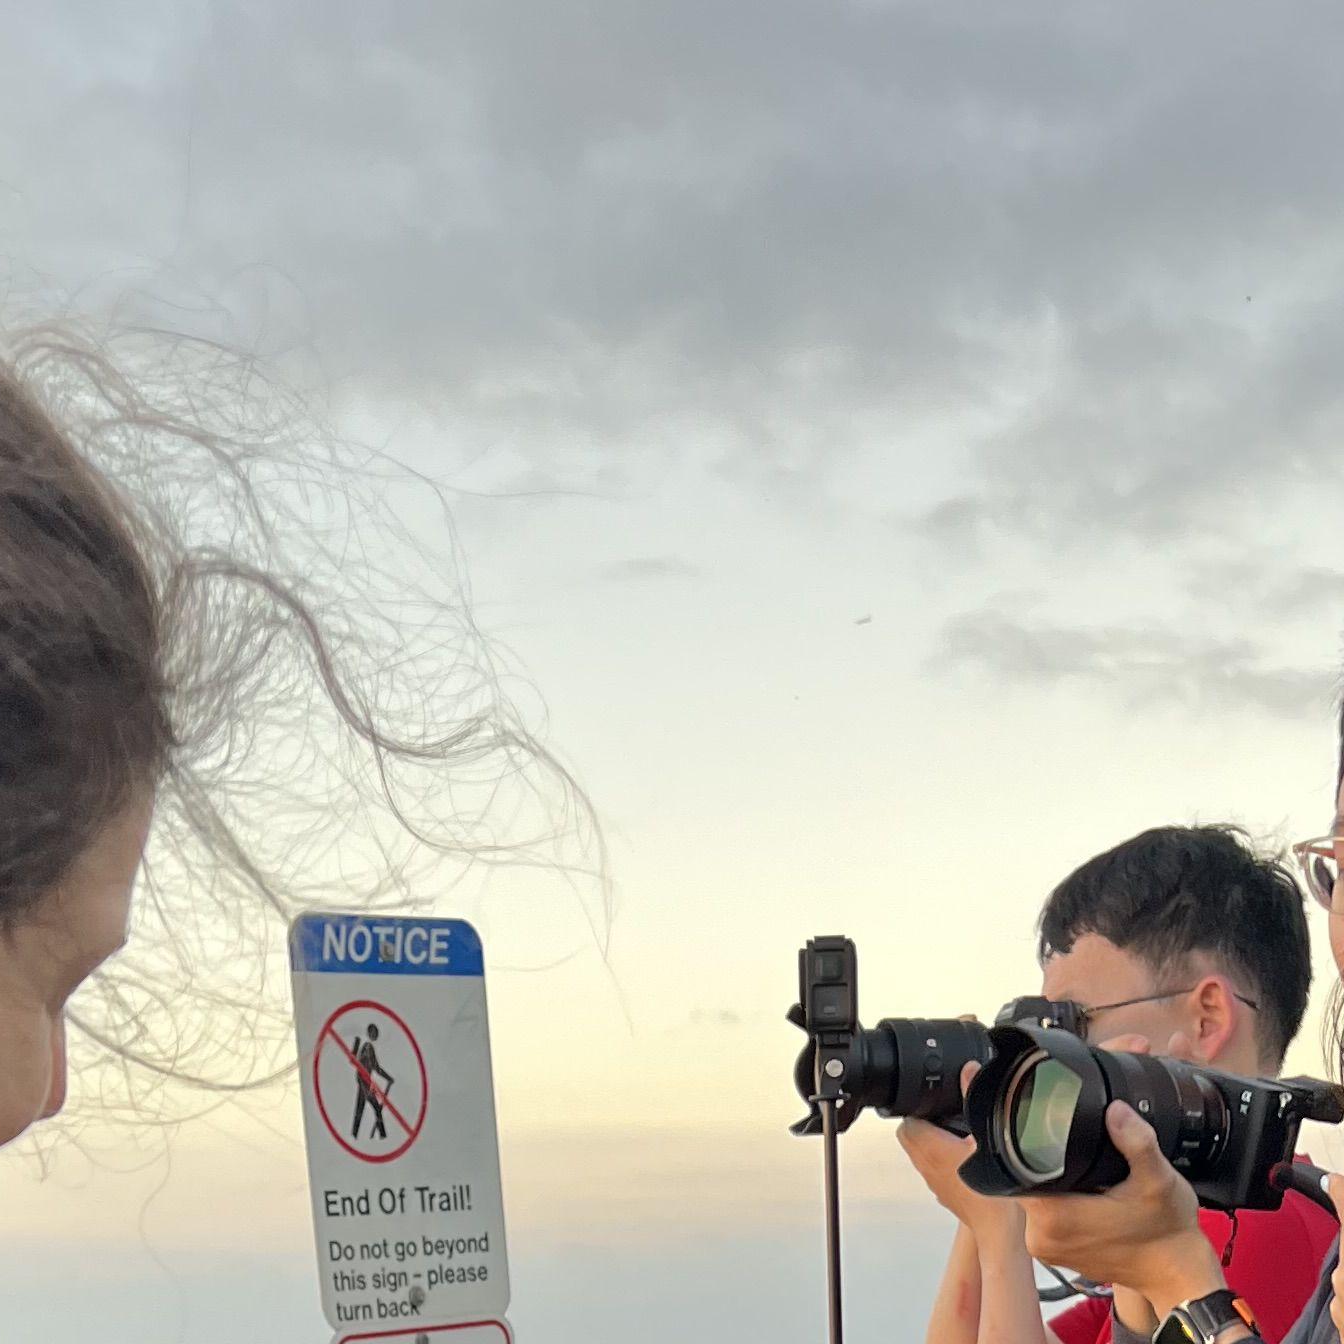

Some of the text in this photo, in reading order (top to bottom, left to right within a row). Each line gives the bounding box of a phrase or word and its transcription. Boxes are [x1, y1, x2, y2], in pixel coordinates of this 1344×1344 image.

[322, 924, 451, 964] NOTICE
[324, 1185, 471, 1217] End Of Trail!
[329, 1232, 489, 1262] Do not go beyond
[334, 1270, 367, 1292] this
[372, 1268, 409, 1292] sign
[427, 1264, 488, 1290] please
[336, 1298, 421, 1322] turn back
